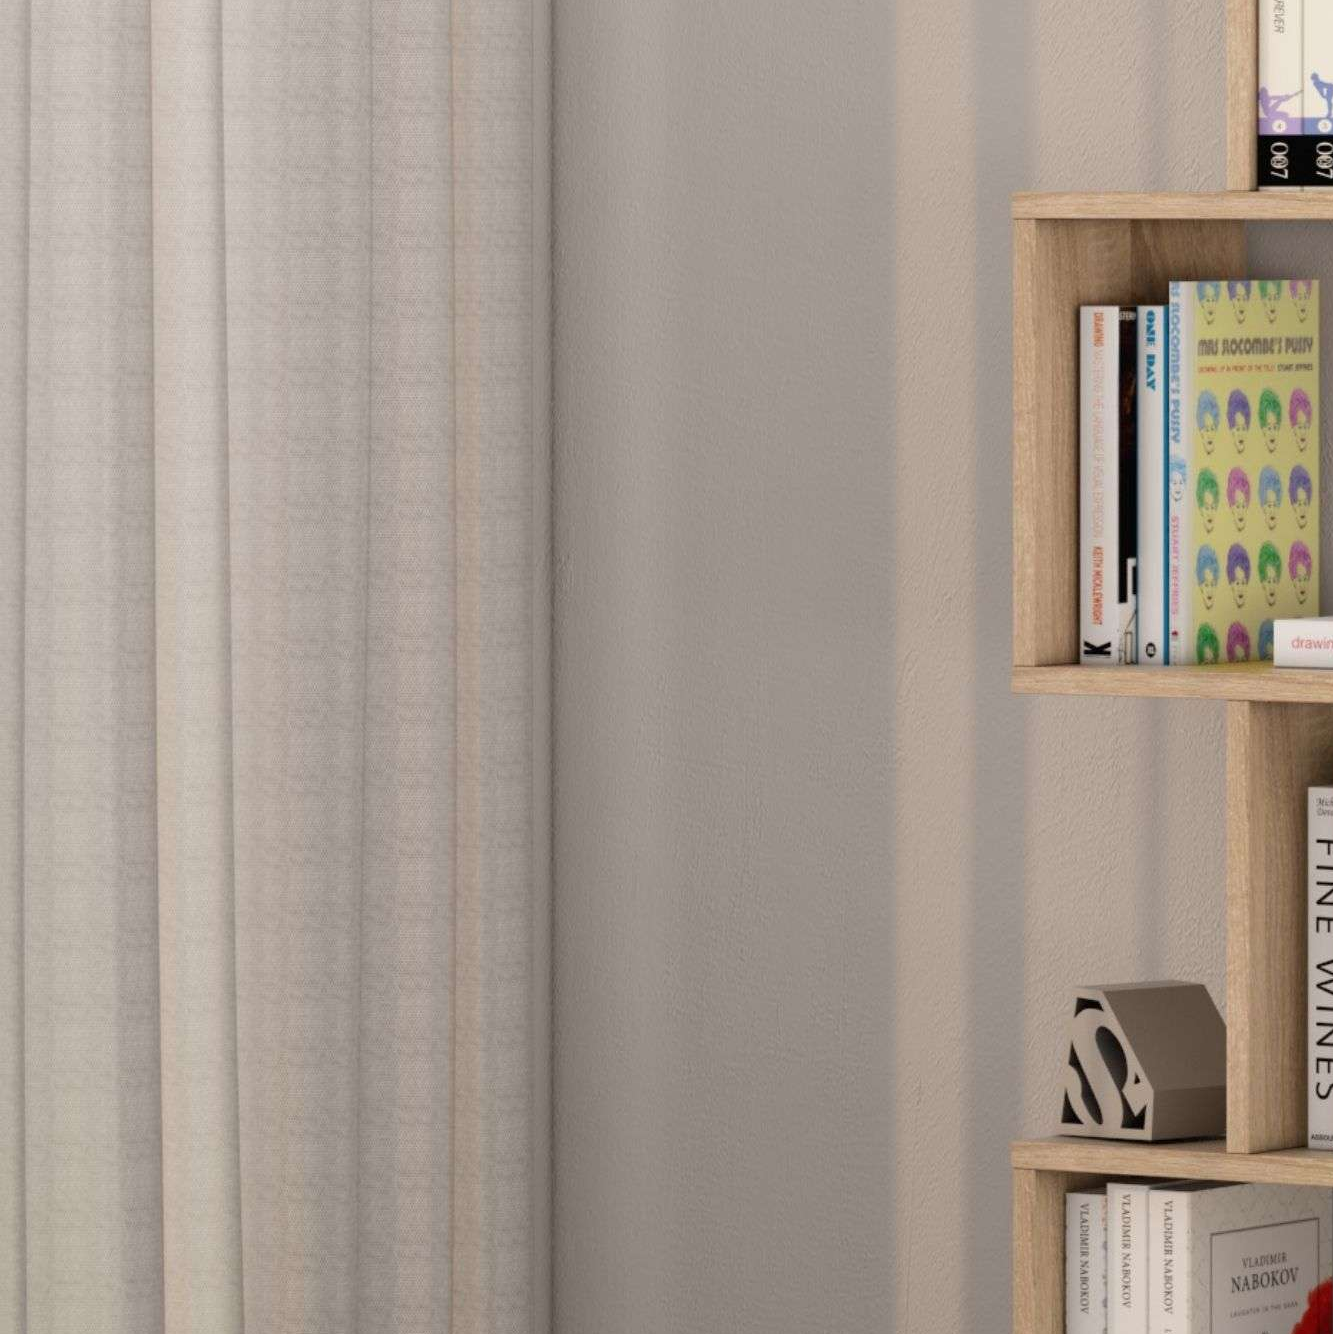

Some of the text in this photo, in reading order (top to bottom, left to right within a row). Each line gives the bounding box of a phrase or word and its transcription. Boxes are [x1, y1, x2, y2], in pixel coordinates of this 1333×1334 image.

[1270, 142, 1289, 179] 007
[1315, 142, 1333, 179] 007
[1146, 310, 1157, 392] ONE DAY
[1080, 1203, 1090, 1257] VLADIMIR
[1121, 1193, 1132, 1250] VLADIMIR
[1163, 1200, 1174, 1256] VLADIMIR
[1080, 1259, 1090, 1315] NABOKOV
[1121, 1253, 1132, 1309] NABOKOV
[1163, 1259, 1174, 1315] NABOKOV
[1231, 1267, 1299, 1293] NABOKOV
[1242, 1252, 1288, 1268] VLADIMIR
